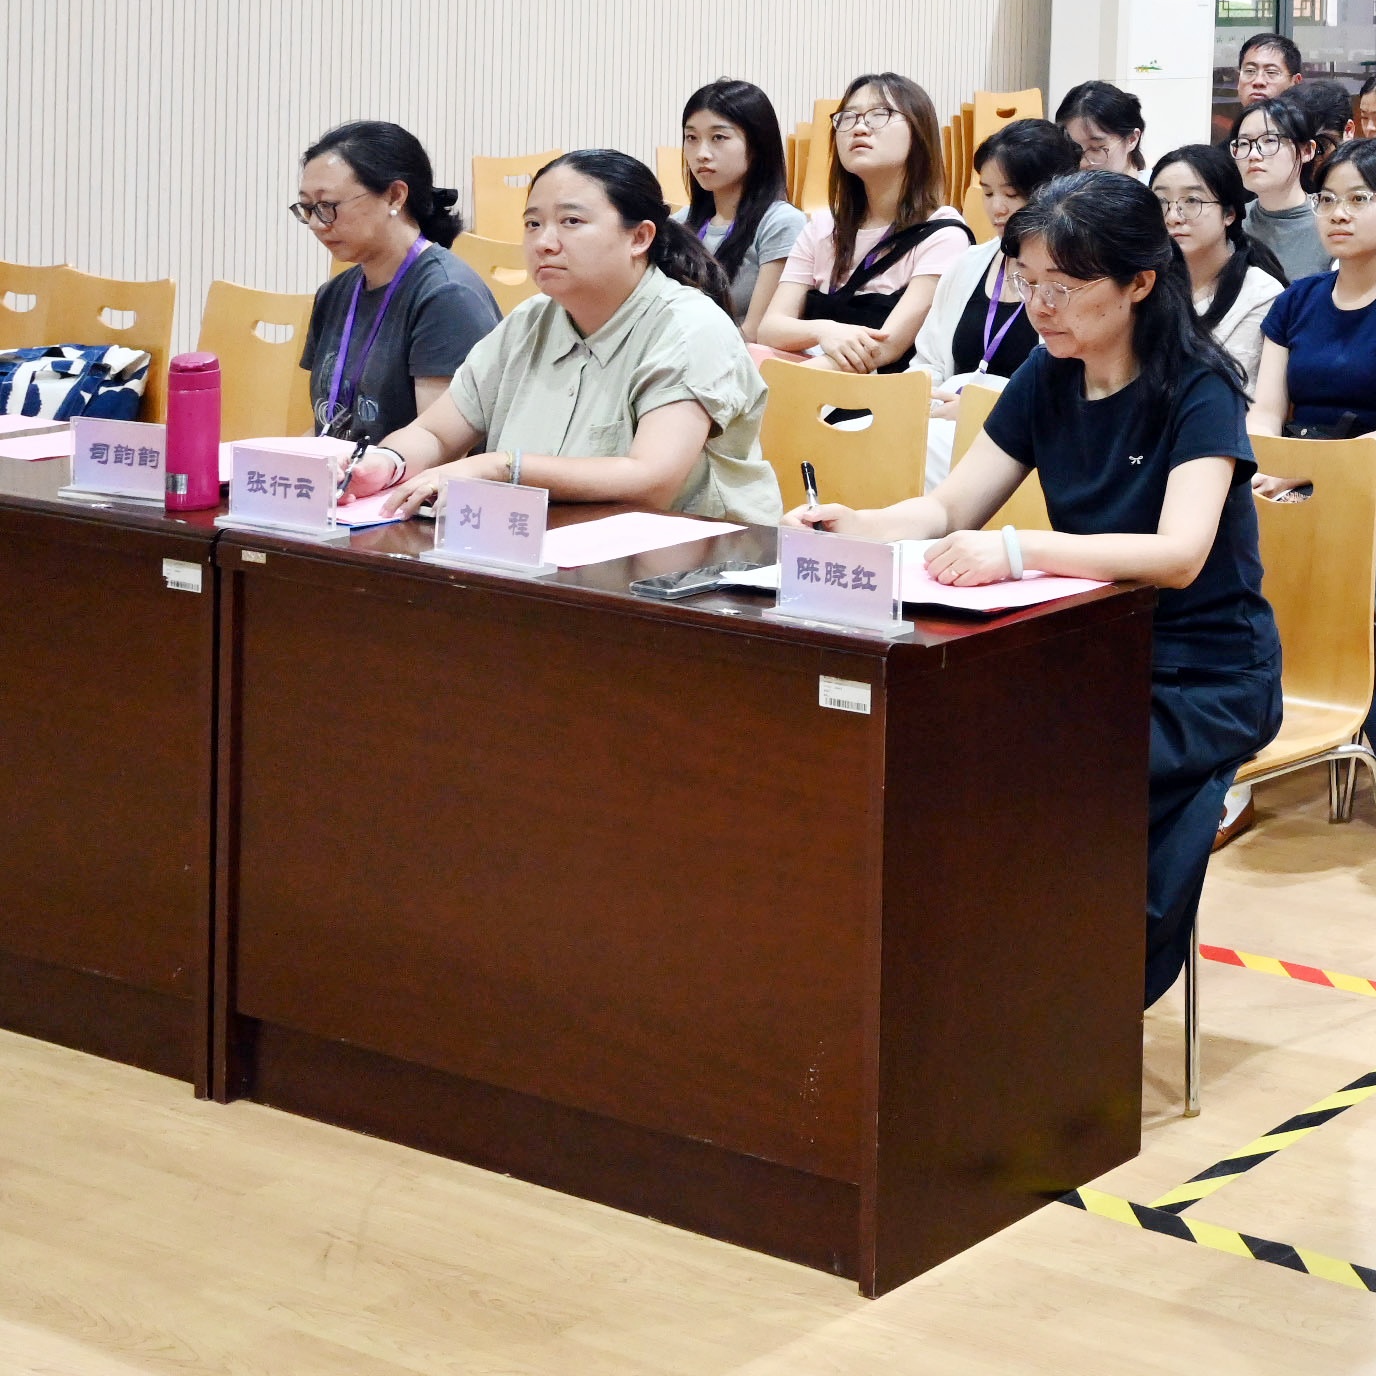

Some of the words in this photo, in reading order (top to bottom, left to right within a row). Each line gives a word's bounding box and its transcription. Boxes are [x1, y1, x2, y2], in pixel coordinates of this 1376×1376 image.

[89, 442, 160, 469] 司韵韵
[247, 471, 315, 499] 张行云
[797, 557, 877, 592] 陈晓红
